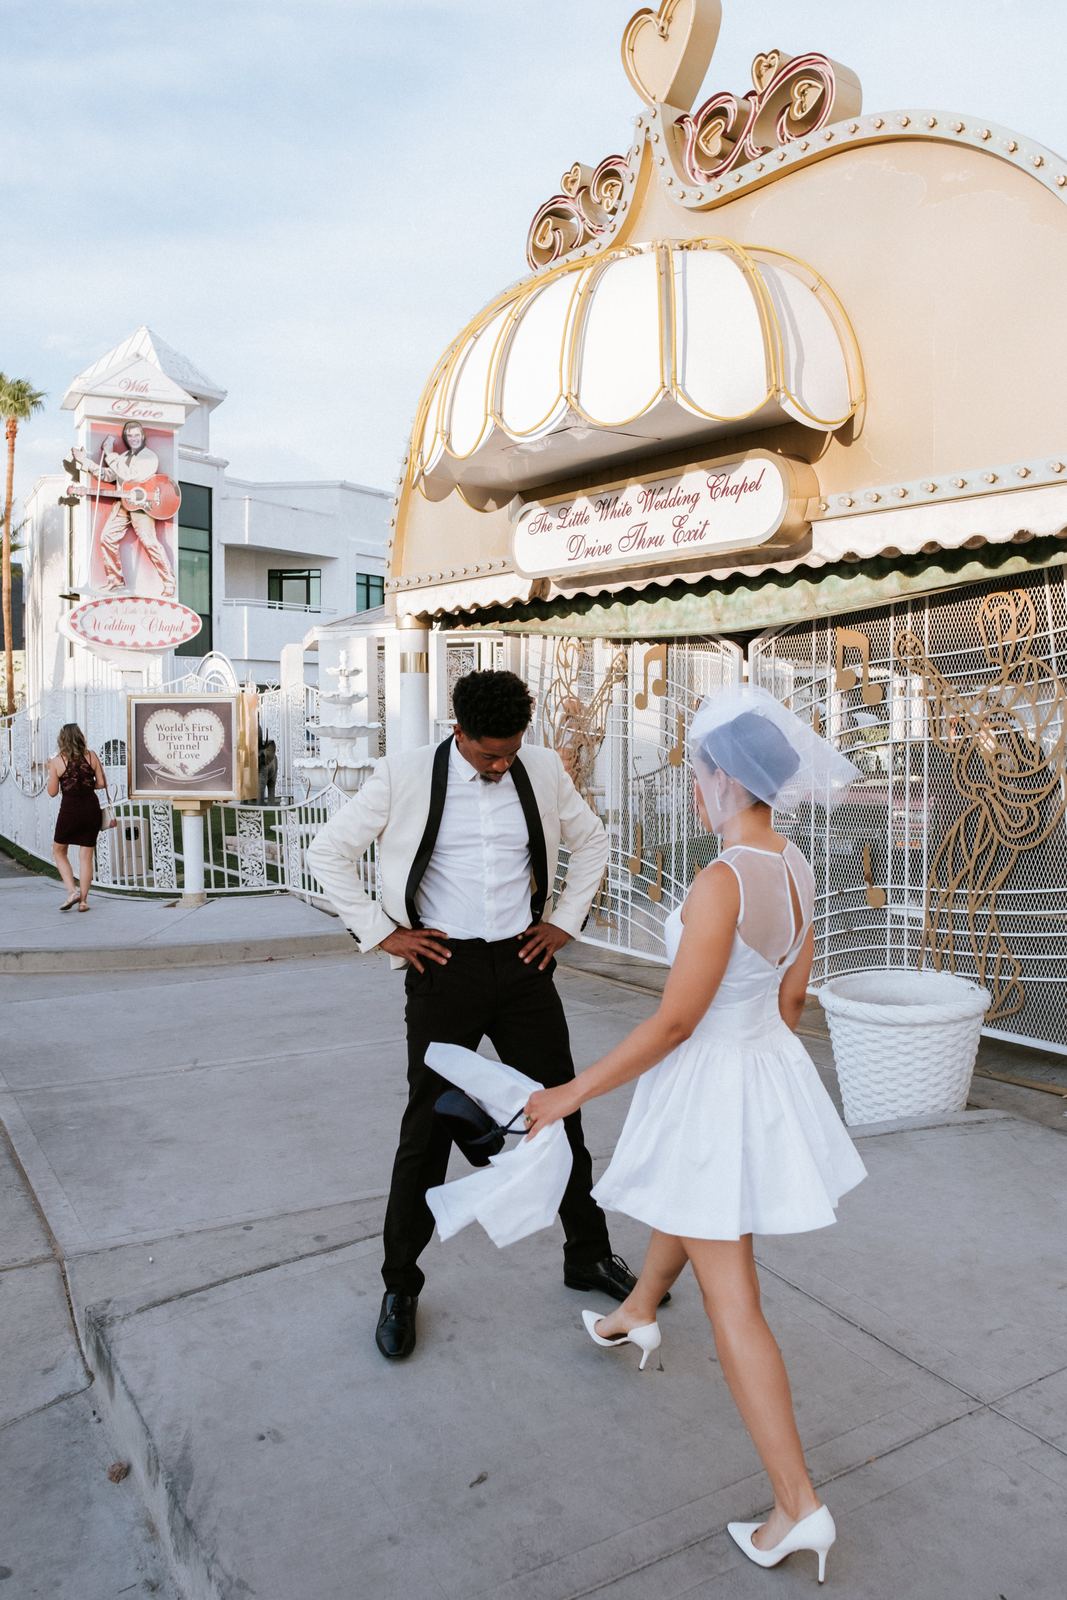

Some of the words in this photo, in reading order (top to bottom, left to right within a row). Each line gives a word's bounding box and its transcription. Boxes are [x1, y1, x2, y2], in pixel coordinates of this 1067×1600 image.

[118, 378, 151, 393] With
[111, 398, 163, 418] Love
[527, 512, 553, 536] The
[556, 506, 591, 530] Little
[595, 494, 633, 523] White
[637, 485, 700, 514] Wedding
[706, 467, 766, 504] Chapel
[567, 534, 613, 562] Drive
[617, 521, 665, 553] Thru
[671, 515, 711, 545] Exit
[91, 616, 136, 636] Wedding
[142, 616, 185, 636] Chapel
[155, 723, 190, 732] World's
[192, 723, 213, 732] First
[158, 733, 183, 741] Drive
[185, 733, 209, 741] Thru
[167, 742, 200, 750] Tunnel
[166, 751, 177, 759] of
[178, 751, 200, 759] Love
